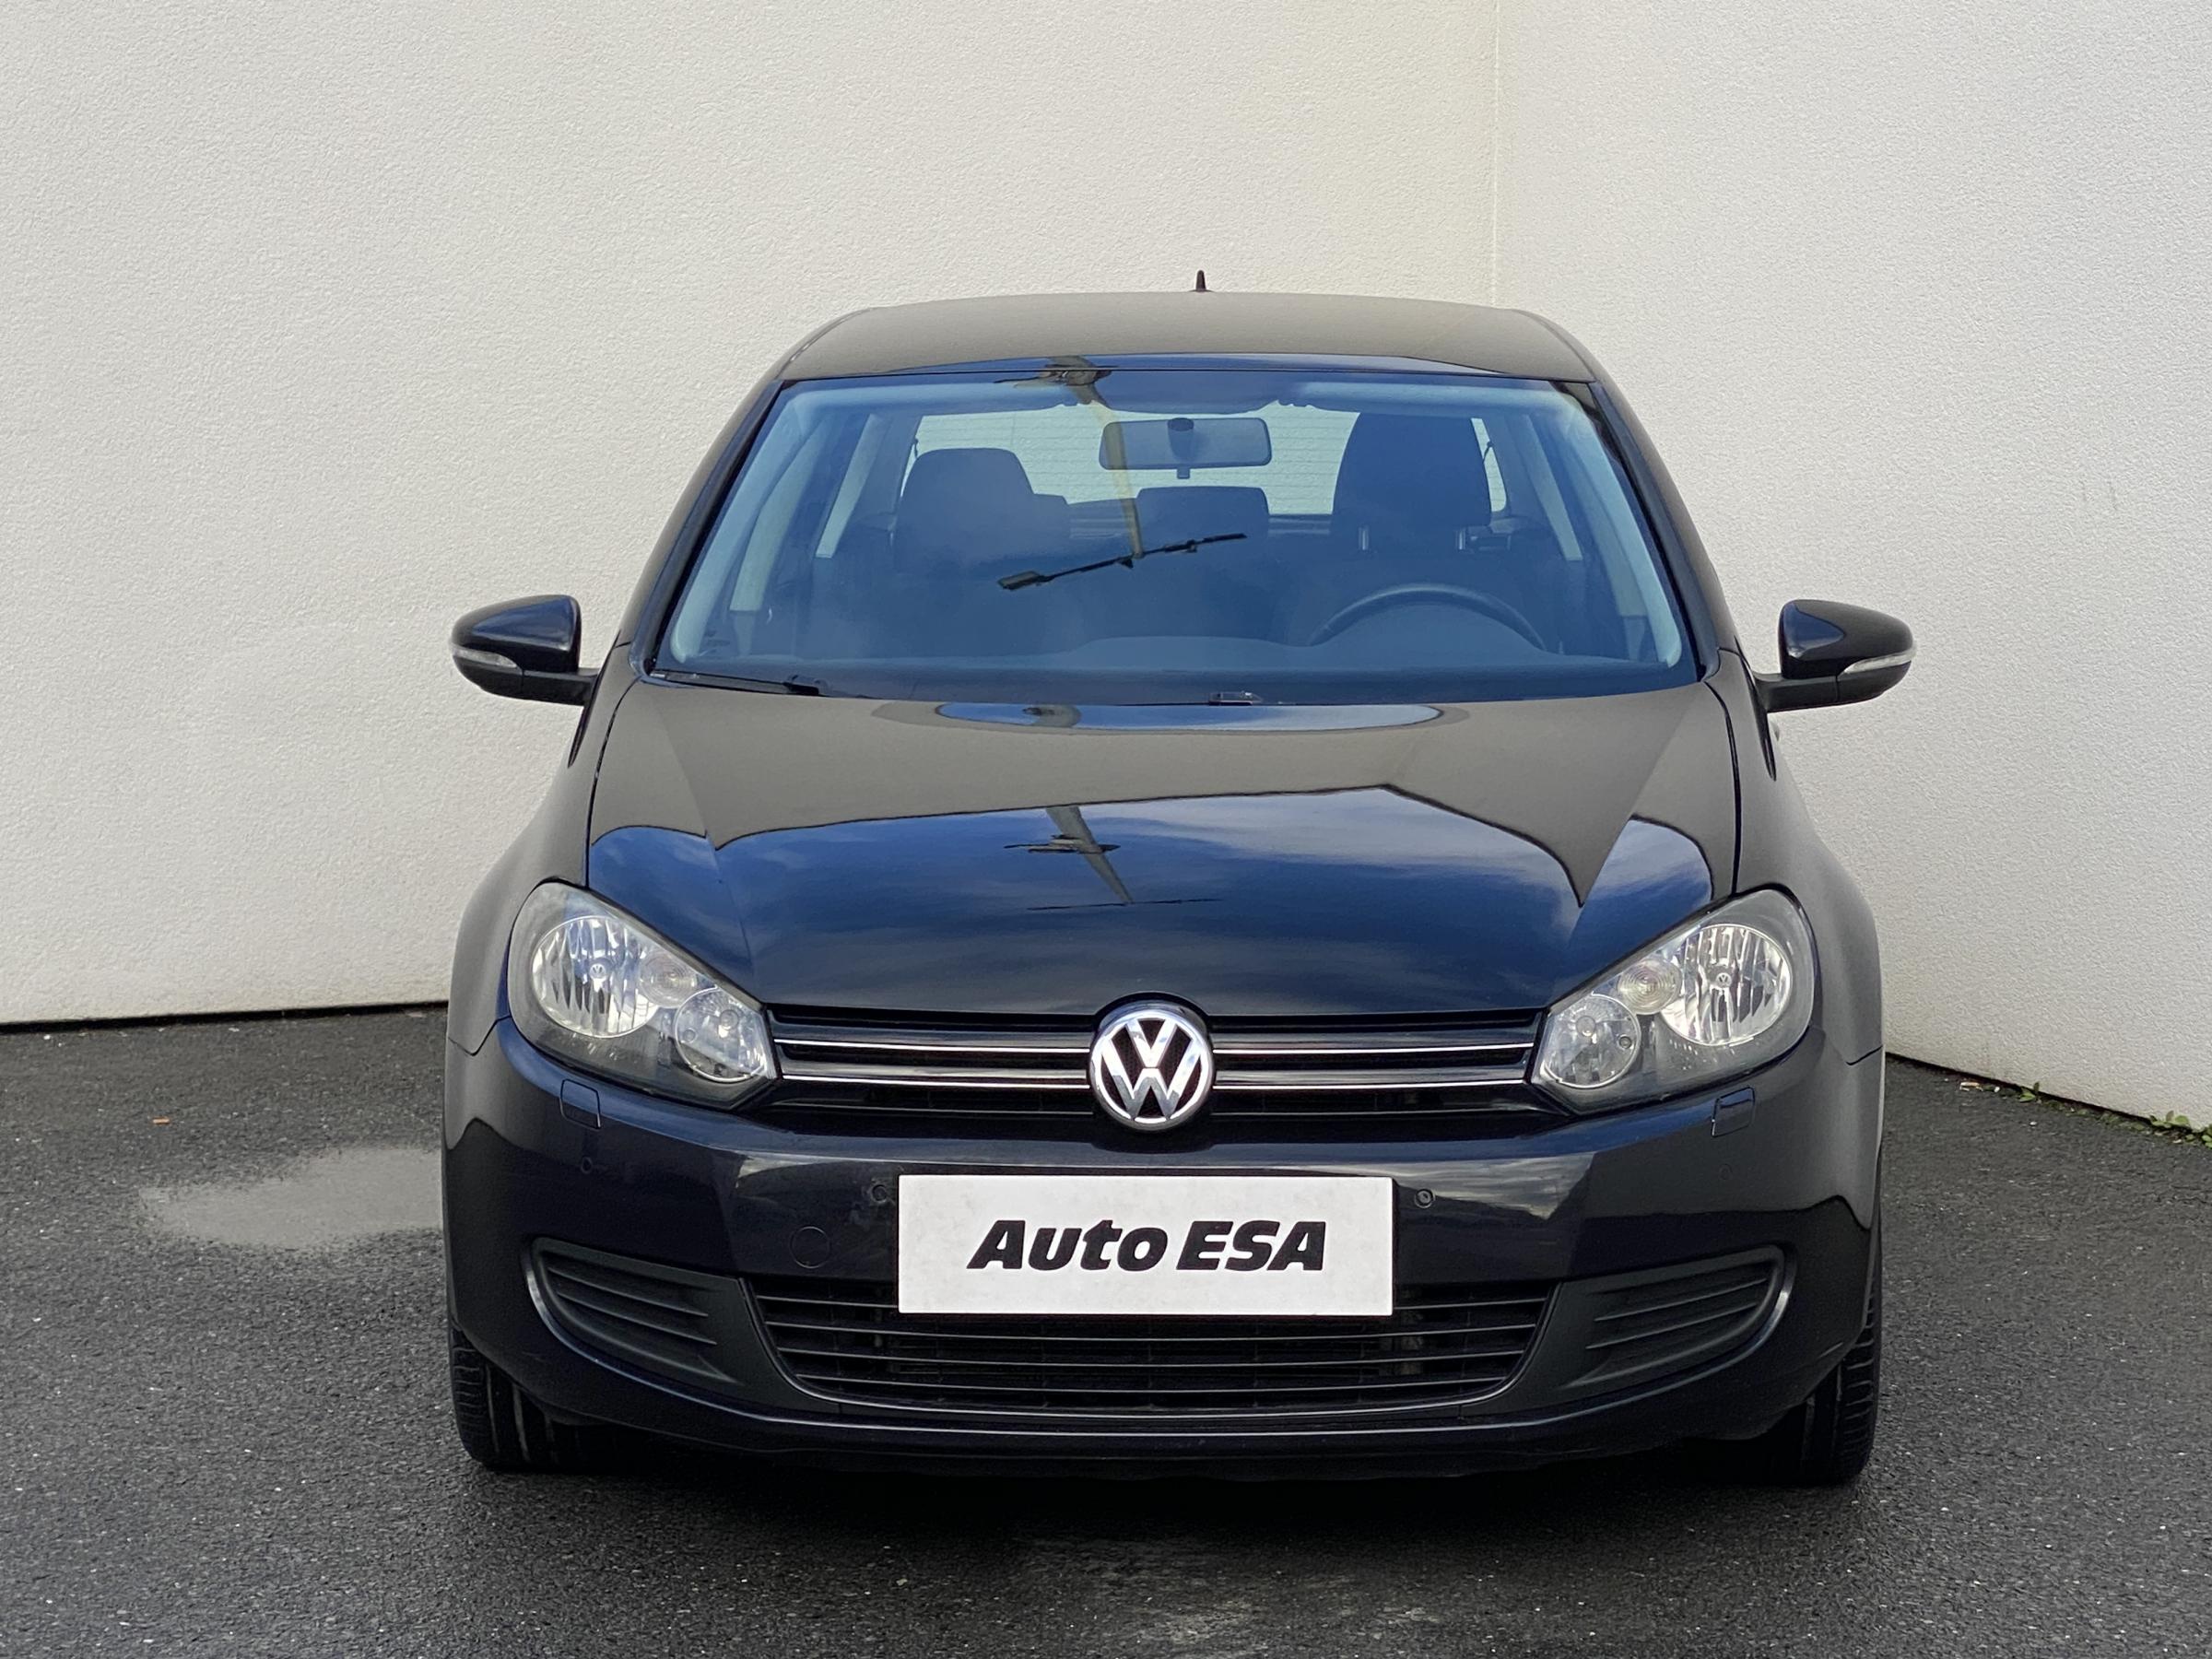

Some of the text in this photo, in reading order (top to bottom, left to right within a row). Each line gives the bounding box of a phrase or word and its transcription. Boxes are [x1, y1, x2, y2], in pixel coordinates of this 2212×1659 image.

[1095, 1013, 1206, 1123] VW
[966, 1219, 1326, 1272] Auto ESA
